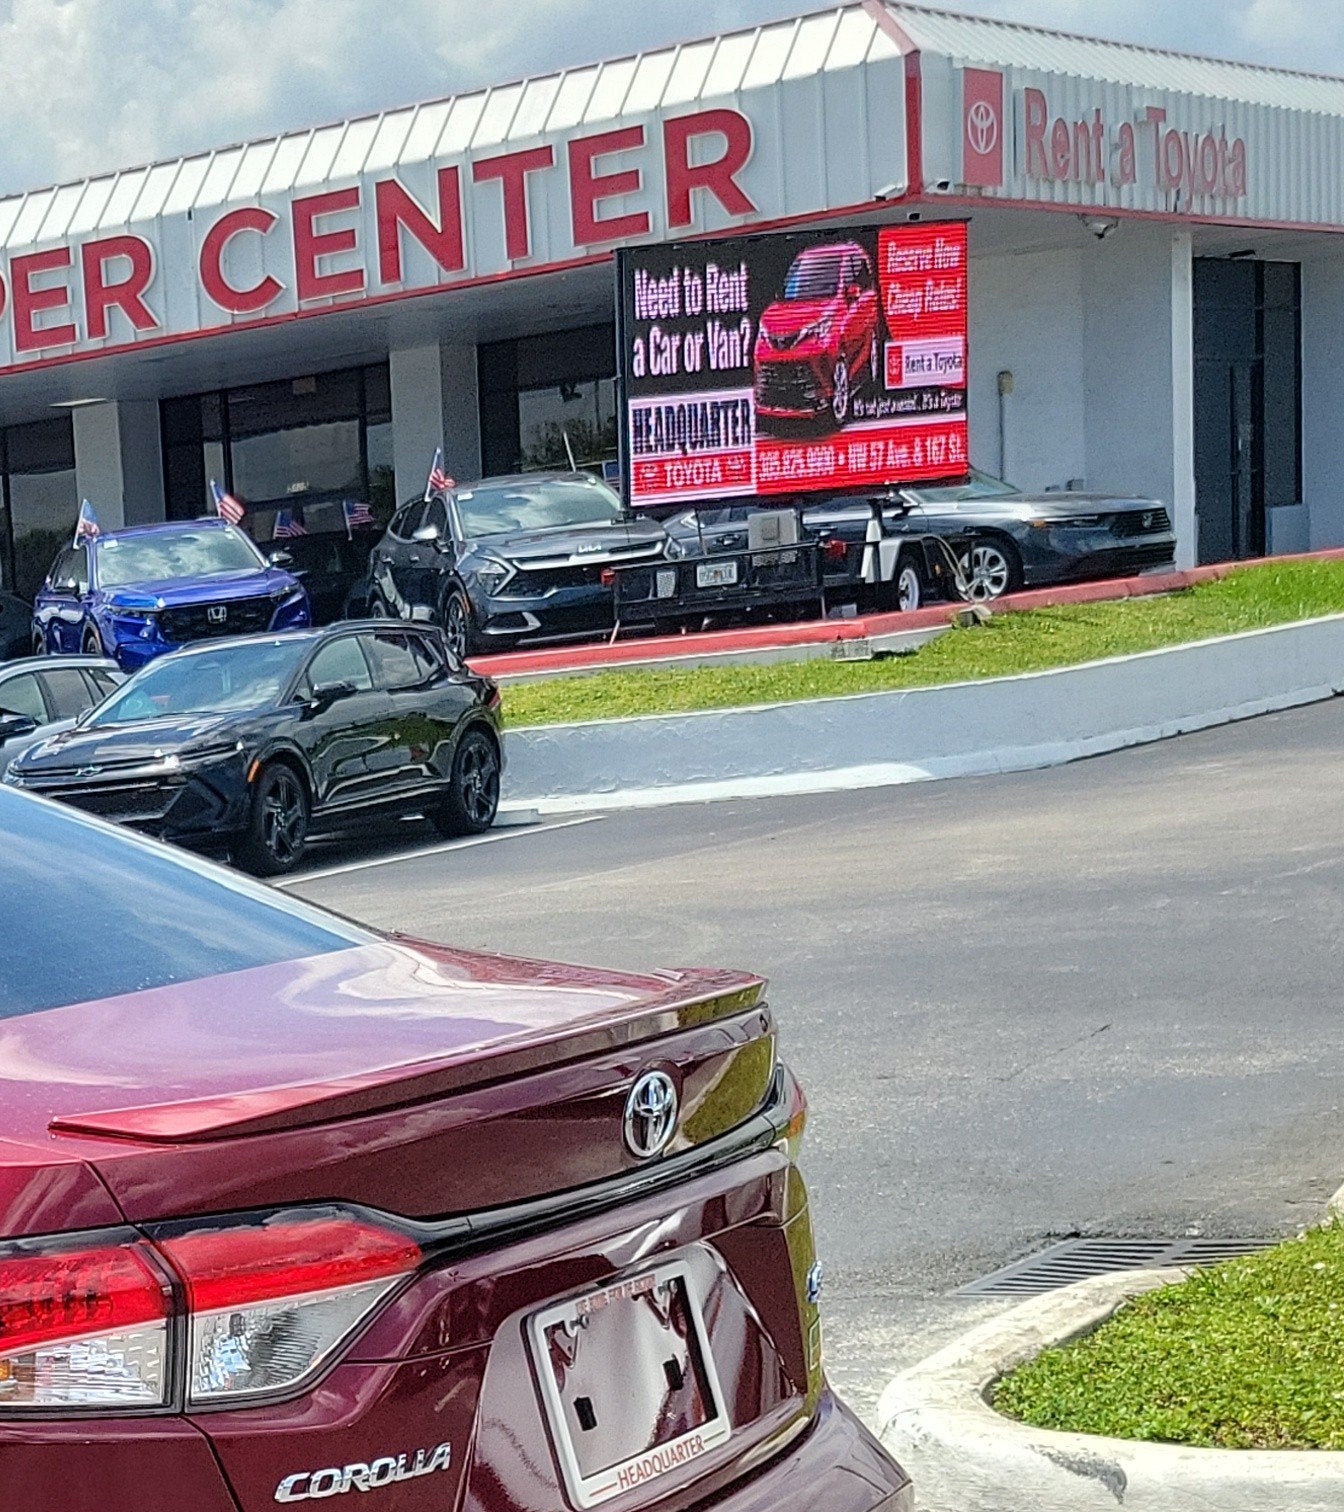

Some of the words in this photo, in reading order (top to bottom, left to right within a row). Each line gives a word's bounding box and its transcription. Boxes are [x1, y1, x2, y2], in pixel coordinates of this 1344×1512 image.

[1024, 87, 1104, 182] Rent
[1118, 120, 1136, 184] a
[1146, 106, 1247, 212] Toyota
[199, 108, 758, 313] CENTER
[634, 266, 680, 320] Need
[683, 266, 702, 316] to
[706, 261, 748, 313] Rent
[633, 335, 646, 378] a
[649, 325, 681, 376] Car
[684, 332, 704, 373] or
[707, 317, 751, 370] Van?
[632, 398, 752, 456] HEADQUARTER
[664, 459, 722, 487] TOYOTA
[274, 1442, 451, 1503] COROLLA
[617, 1434, 706, 1490] HEADQUARTER
